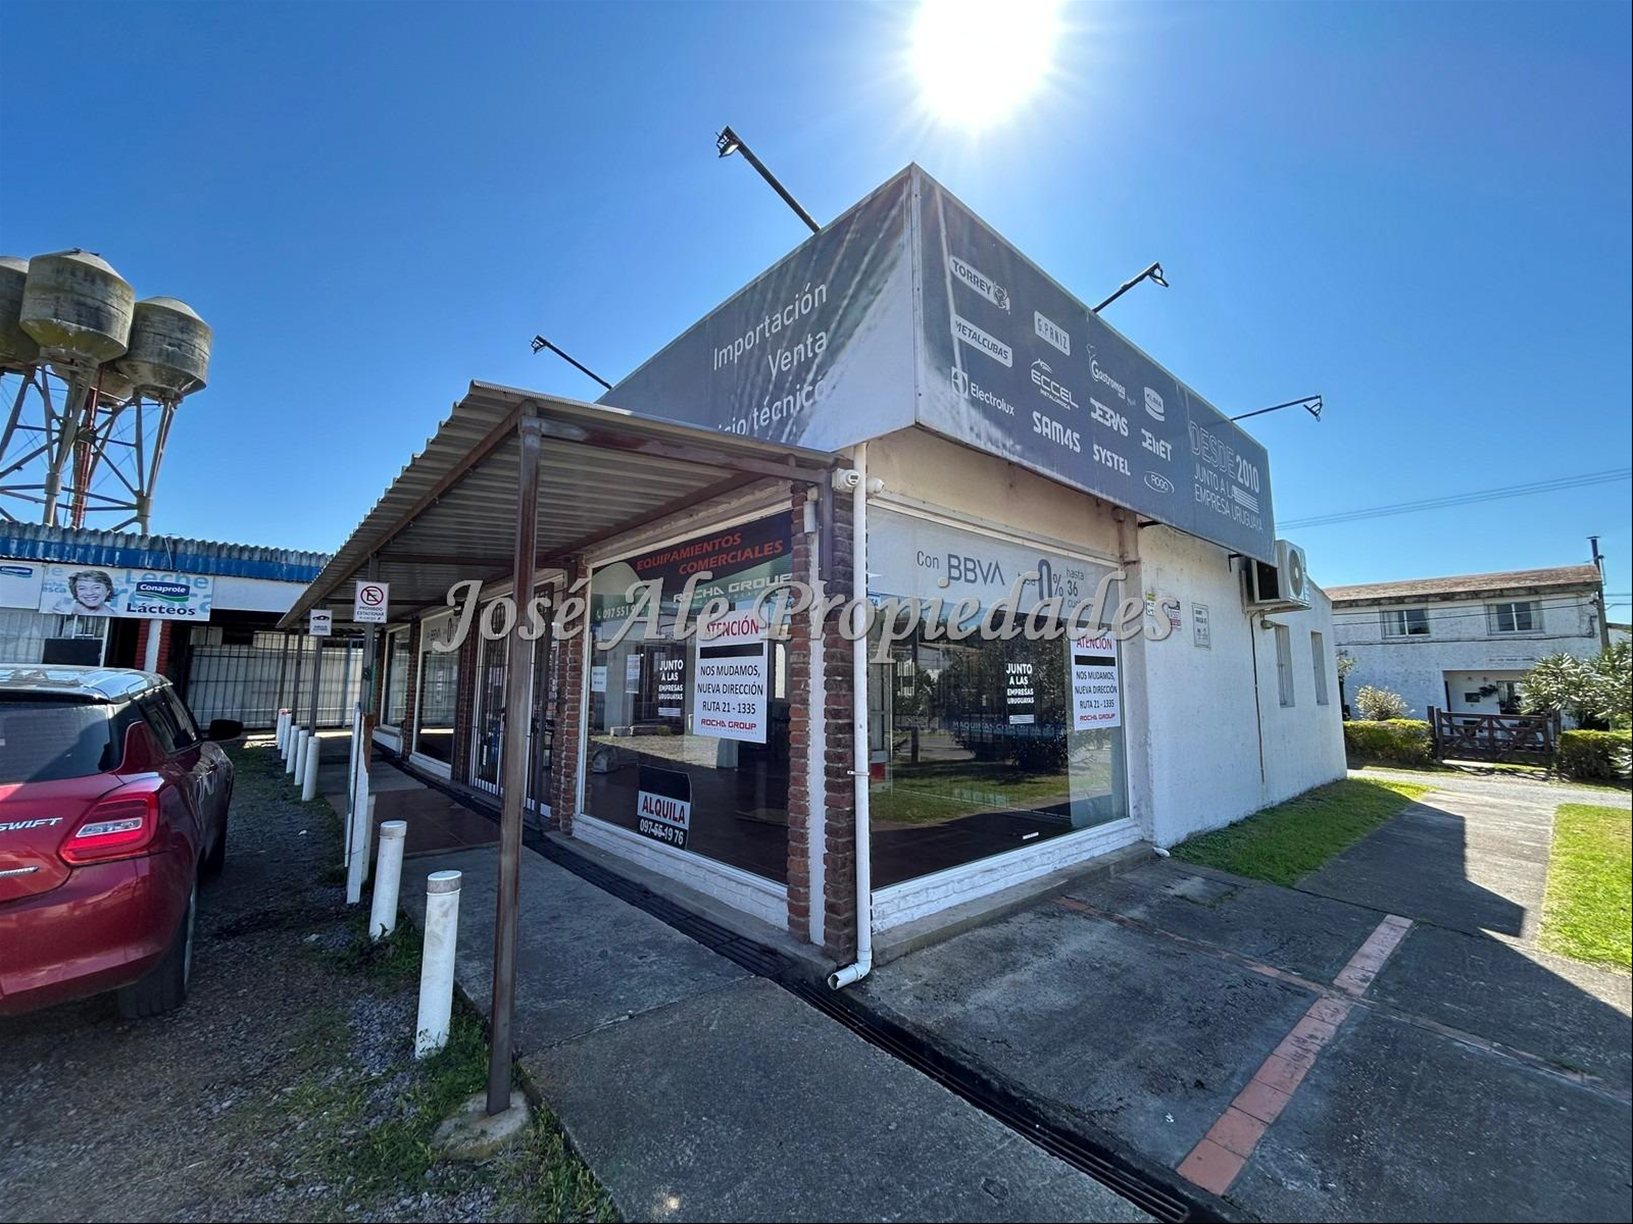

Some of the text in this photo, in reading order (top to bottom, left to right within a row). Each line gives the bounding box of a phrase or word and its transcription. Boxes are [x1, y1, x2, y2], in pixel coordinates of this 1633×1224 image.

[952, 259, 992, 295] TORREY
[714, 282, 827, 370] Importación
[768, 331, 827, 379] Venta
[1031, 369, 1079, 409] ECCEL
[752, 378, 825, 431] técnico
[970, 382, 1015, 416] Electrolux
[1032, 411, 1080, 453] SAM4S
[1093, 444, 1131, 476] SYSTEL
[1189, 420, 1260, 493] DESDE 2010
[1194, 463, 1219, 491] JUNTO
[1220, 478, 1227, 497] A
[1195, 483, 1231, 518] EMPRESA
[636, 533, 742, 571] EQUIPAMIENTOS
[679, 540, 784, 575] COMERCIALES
[917, 550, 1006, 586] Con BBVA
[1066, 568, 1084, 580] hasta
[140, 584, 186, 593] Conaprole
[729, 573, 793, 593] GROUP
[1067, 580, 1079, 597] 36
[126, 602, 196, 616] Lácteos
[602, 608, 615, 619] 097
[617, 606, 629, 617] 551
[705, 616, 759, 637] ATENCIÓN
[659, 660, 684, 671] JUNTO
[700, 665, 760, 678] NOS MUDAMOS,
[1006, 663, 1033, 674] JUNTO
[661, 672, 679, 681] A LAS
[1009, 676, 1028, 685] A LAS
[1076, 671, 1087, 680] NOS
[658, 684, 683, 692] EMPRESAS
[697, 682, 764, 696] NUEVA DIRECCIÓN
[1007, 688, 1034, 696] EMPRESAS
[1075, 684, 1117, 694] NUEVA DIRECCIÓN
[702, 701, 721, 712] RUTA
[722, 702, 731, 713] 21
[737, 703, 756, 714] 1335
[1080, 701, 1093, 709] RUTA
[1094, 701, 1100, 709] 21
[1103, 699, 1115, 708] 1335
[700, 719, 757, 730] ROCHA GROUP
[642, 796, 686, 825] ALQUILA
[0, 817, 63, 831] SWIFT
[674, 829, 684, 845] 76
